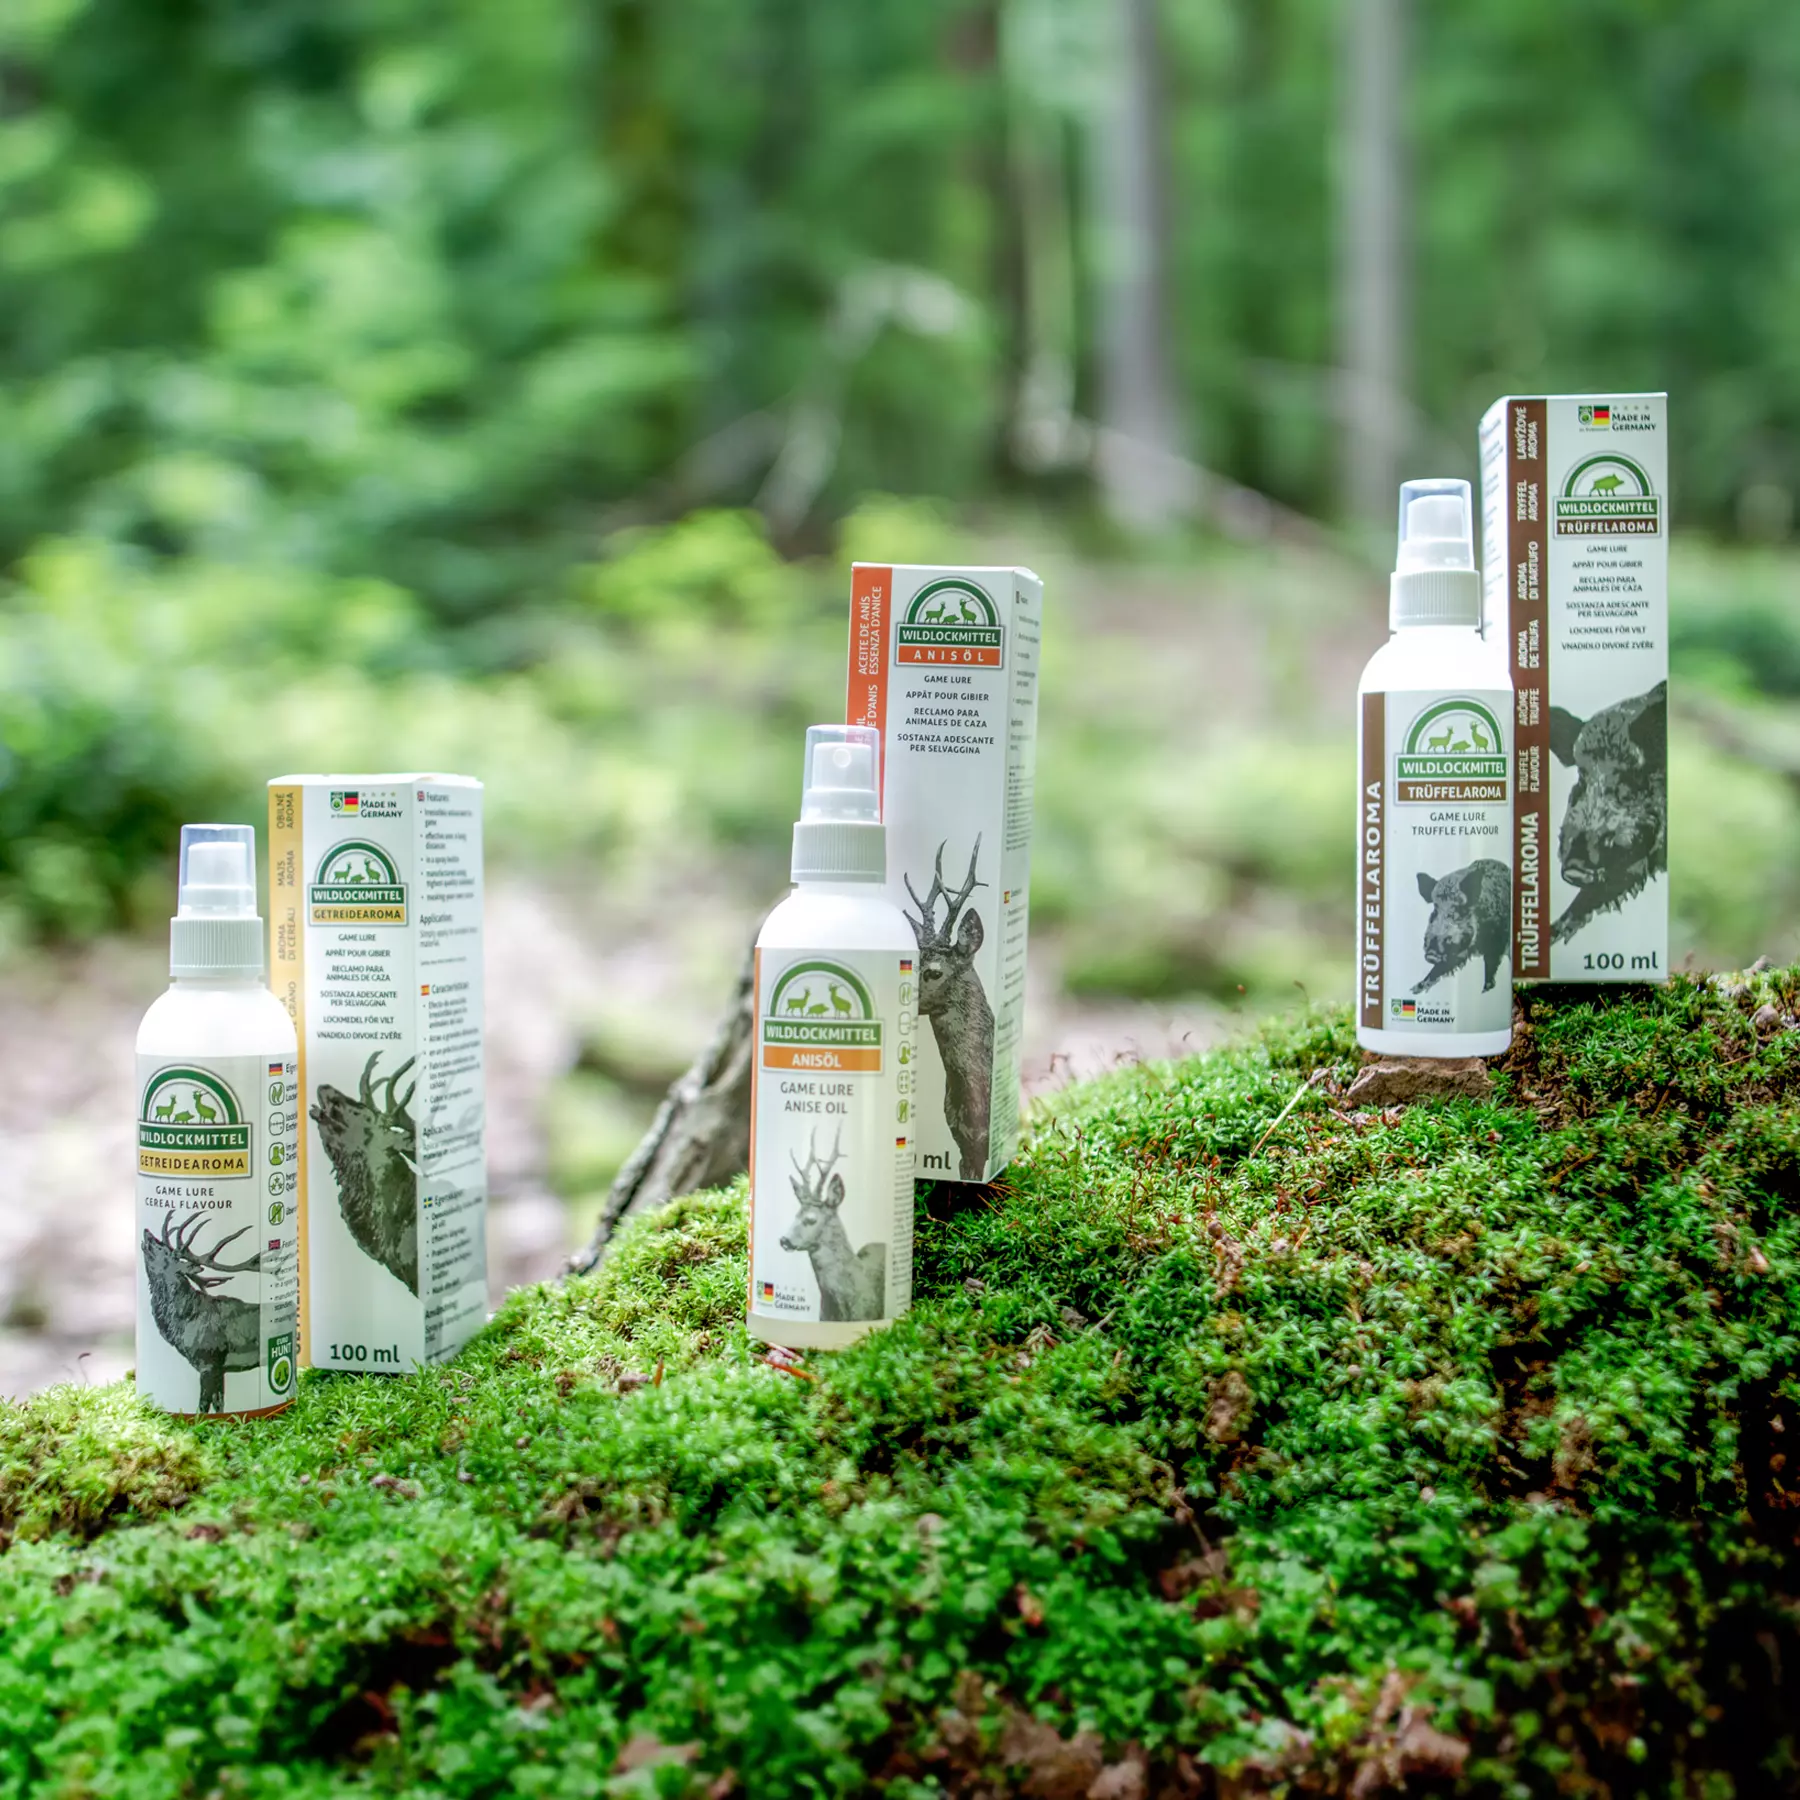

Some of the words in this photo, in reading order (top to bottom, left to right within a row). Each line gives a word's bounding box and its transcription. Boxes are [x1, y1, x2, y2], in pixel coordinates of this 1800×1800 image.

[1559, 503, 1654, 514] WILDLOCKMITTEL
[1559, 520, 1654, 533] TRÜFFELAROMA
[1586, 545, 1608, 553] GAME
[1610, 545, 1628, 553] LURE
[1579, 576, 1615, 584] RECLAMO
[1622, 584, 1643, 592] CAZA
[1578, 610, 1592, 618] PER
[860, 623, 870, 637] DE
[902, 630, 998, 643] WILDLOCKMITTEL
[858, 640, 868, 675] ACEITE
[869, 629, 880, 675] ESSENZA
[924, 675, 948, 684] GAME
[950, 676, 972, 684] LURE
[906, 690, 932, 699] APPÂT
[934, 692, 958, 700] POUR
[960, 693, 990, 701] GIBIER
[914, 708, 954, 716] RECLAMO
[957, 709, 980, 717] PARA
[906, 718, 948, 727] ANIMALES
[950, 719, 962, 727] DE
[964, 720, 987, 728] CAZA
[897, 734, 942, 742] SOSTANZA
[944, 736, 994, 744] ADESCANTE
[910, 744, 926, 752] PER
[928, 745, 980, 754] SELVAGGINA
[1402, 762, 1504, 774] WILDLOCKMITTEL
[1530, 746, 1540, 793] FLAVOUR
[1408, 784, 1502, 798] TRÜFFELAROMA
[286, 792, 294, 829] AROMA
[1430, 812, 1460, 822] GAME
[1462, 812, 1486, 821] LURE
[1412, 826, 1456, 836] TRUFFLE
[1458, 826, 1499, 836] FLAVOUR
[287, 850, 295, 887] AROMA
[314, 890, 402, 901] WILDLOCKMITTEL
[1363, 781, 1382, 1008] TRÜFFELAROMA
[1517, 812, 1539, 970] TRÜFFELAROMA
[314, 909, 402, 920] GETREIDEAROMA
[338, 933, 357, 941] GAME
[359, 933, 376, 941] LURE
[348, 949, 366, 957] POUR
[368, 949, 391, 957] GIBIER
[1584, 952, 1624, 970] 100
[1631, 950, 1658, 970] ml
[332, 965, 364, 973] RECLAMO
[366, 965, 384, 973] PARA
[326, 974, 360, 982] ANIMALES
[361, 974, 370, 982] DE
[372, 974, 391, 982] CAZA
[320, 990, 354, 998] SOSTANZA
[356, 990, 398, 999] ADESCANTE
[766, 1025, 877, 1041] WILDLOCKMITTEL
[792, 1052, 842, 1068] ANISÖL
[780, 1081, 816, 1095] GAME
[820, 1083, 854, 1096] LURE
[784, 1100, 822, 1113] ANISE
[826, 1102, 848, 1114] OIL
[140, 1130, 244, 1145] WILDLOCKMITTEL
[140, 1155, 244, 1170] GETREIDEAROMA
[924, 1151, 952, 1170] ml
[156, 1185, 182, 1196] GAME
[186, 1187, 214, 1196] LURE
[145, 1197, 176, 1208] CEREAL
[180, 1200, 232, 1209] FLAVOUR
[272, 1342, 292, 1358] HUNT
[330, 1344, 368, 1361] 100
[373, 1344, 400, 1363] ml
